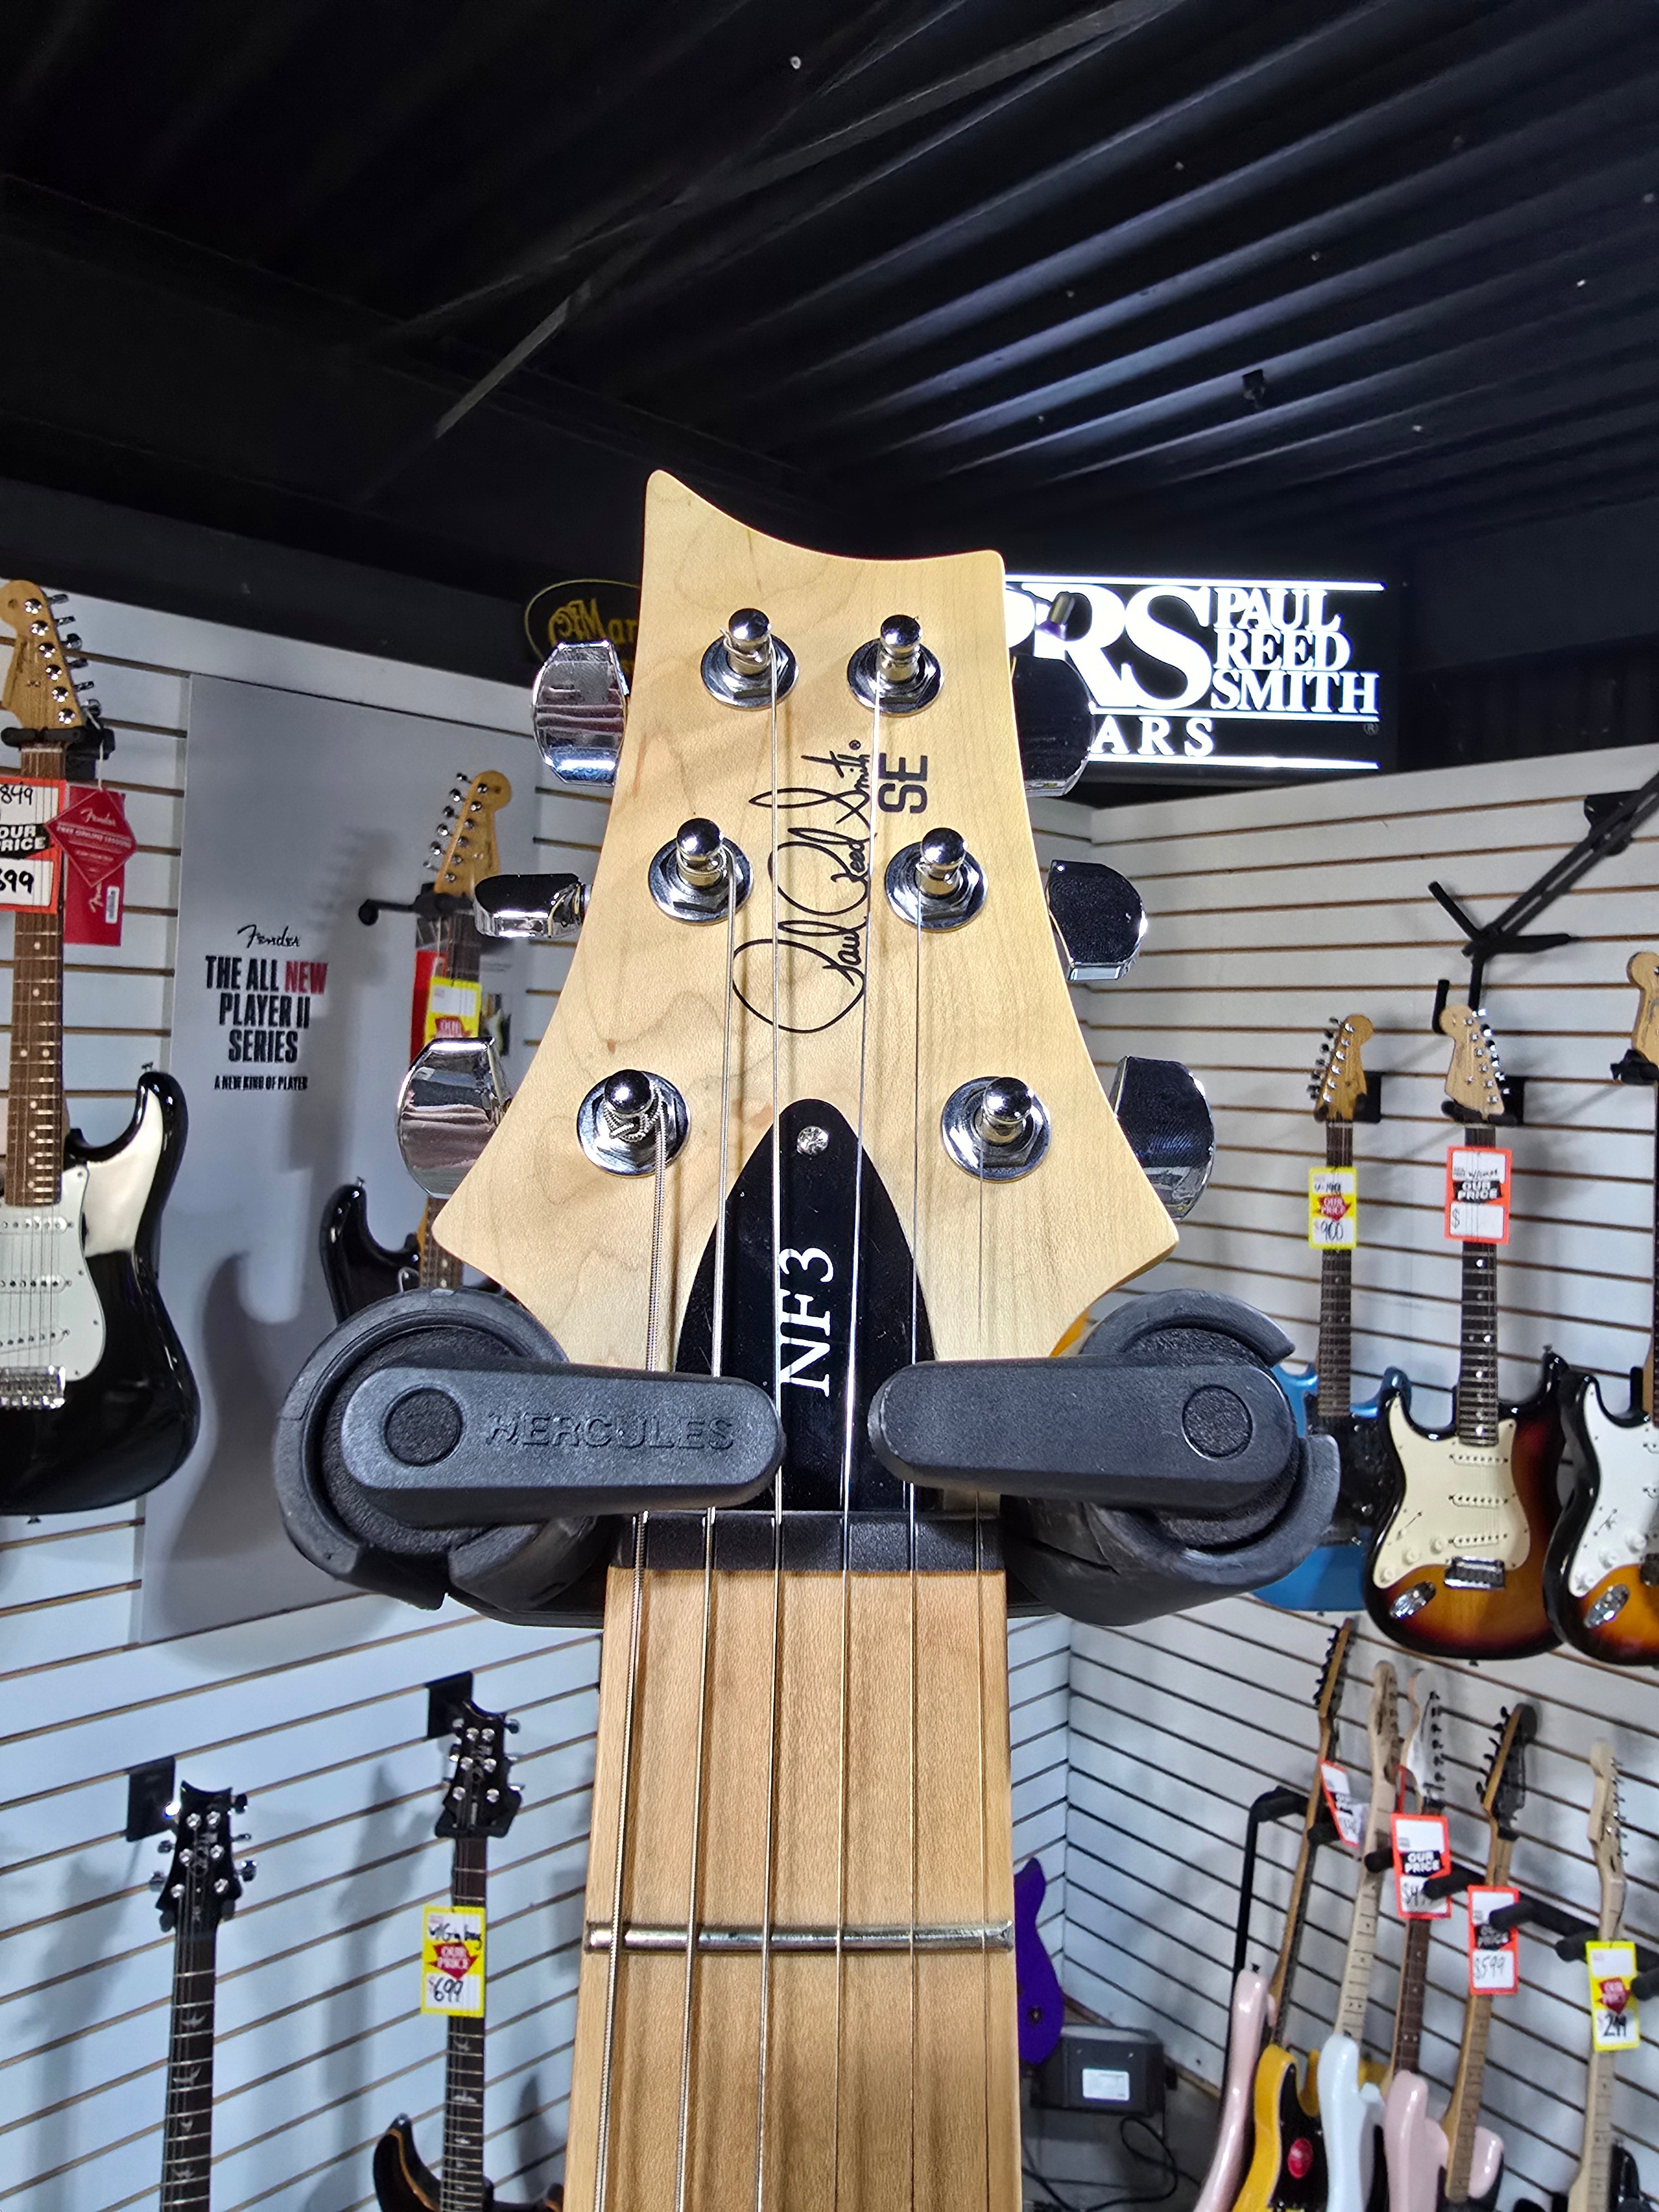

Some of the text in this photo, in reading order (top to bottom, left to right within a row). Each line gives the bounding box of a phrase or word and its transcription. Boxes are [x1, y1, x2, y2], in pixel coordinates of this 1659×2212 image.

[1213, 587, 1342, 632] PAUL
[1213, 628, 1352, 672] REED
[1211, 669, 1380, 715] SMITH
[878, 752, 928, 814] SE
[0, 825, 36, 839] OUR
[0, 837, 46, 852] RICE
[237, 924, 300, 948] Fender
[205, 955, 329, 994] THE ALL NEW
[219, 993, 293, 1029] PLAYER
[228, 1029, 299, 1063] SERIES
[486, 1412, 738, 1451] HERCULES
[1407, 1851, 1435, 1863] OUR
